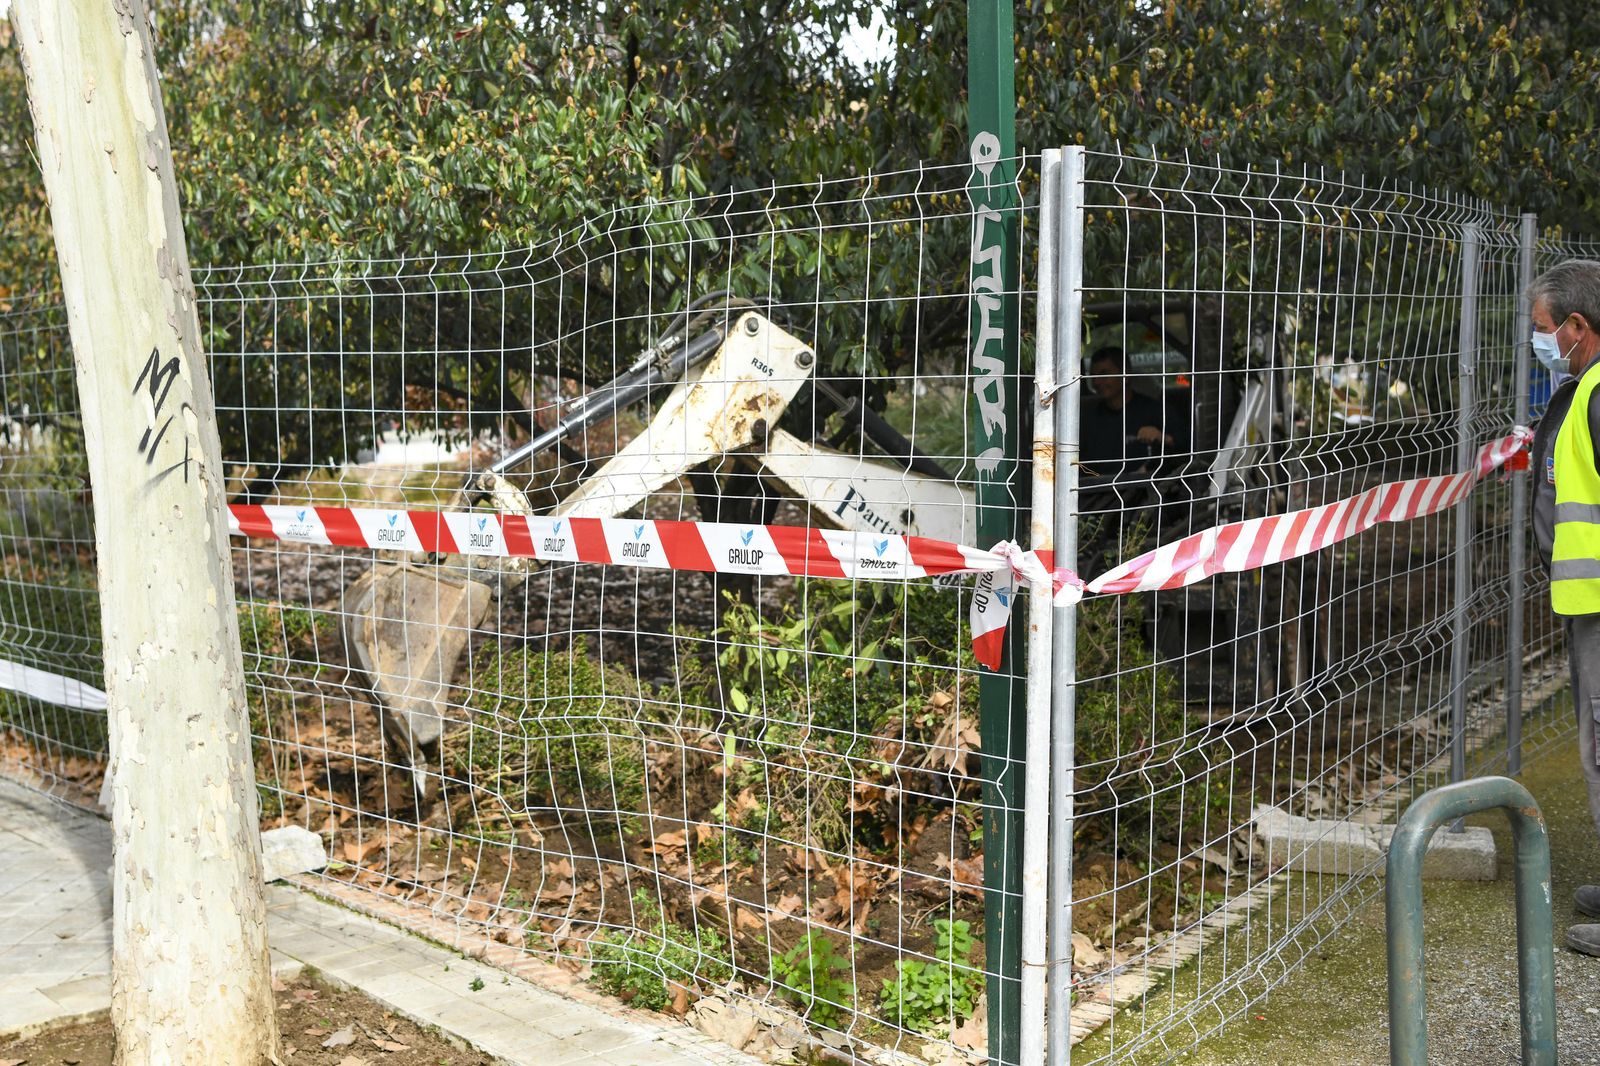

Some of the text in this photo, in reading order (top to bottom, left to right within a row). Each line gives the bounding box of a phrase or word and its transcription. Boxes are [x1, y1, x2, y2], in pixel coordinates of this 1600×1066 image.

[377, 528, 405, 542] GRULOP
[544, 537, 566, 552] GRULOP
[622, 542, 650, 558] GRULOP
[728, 548, 764, 565] GRULOP
[974, 570, 994, 613] RULOP
